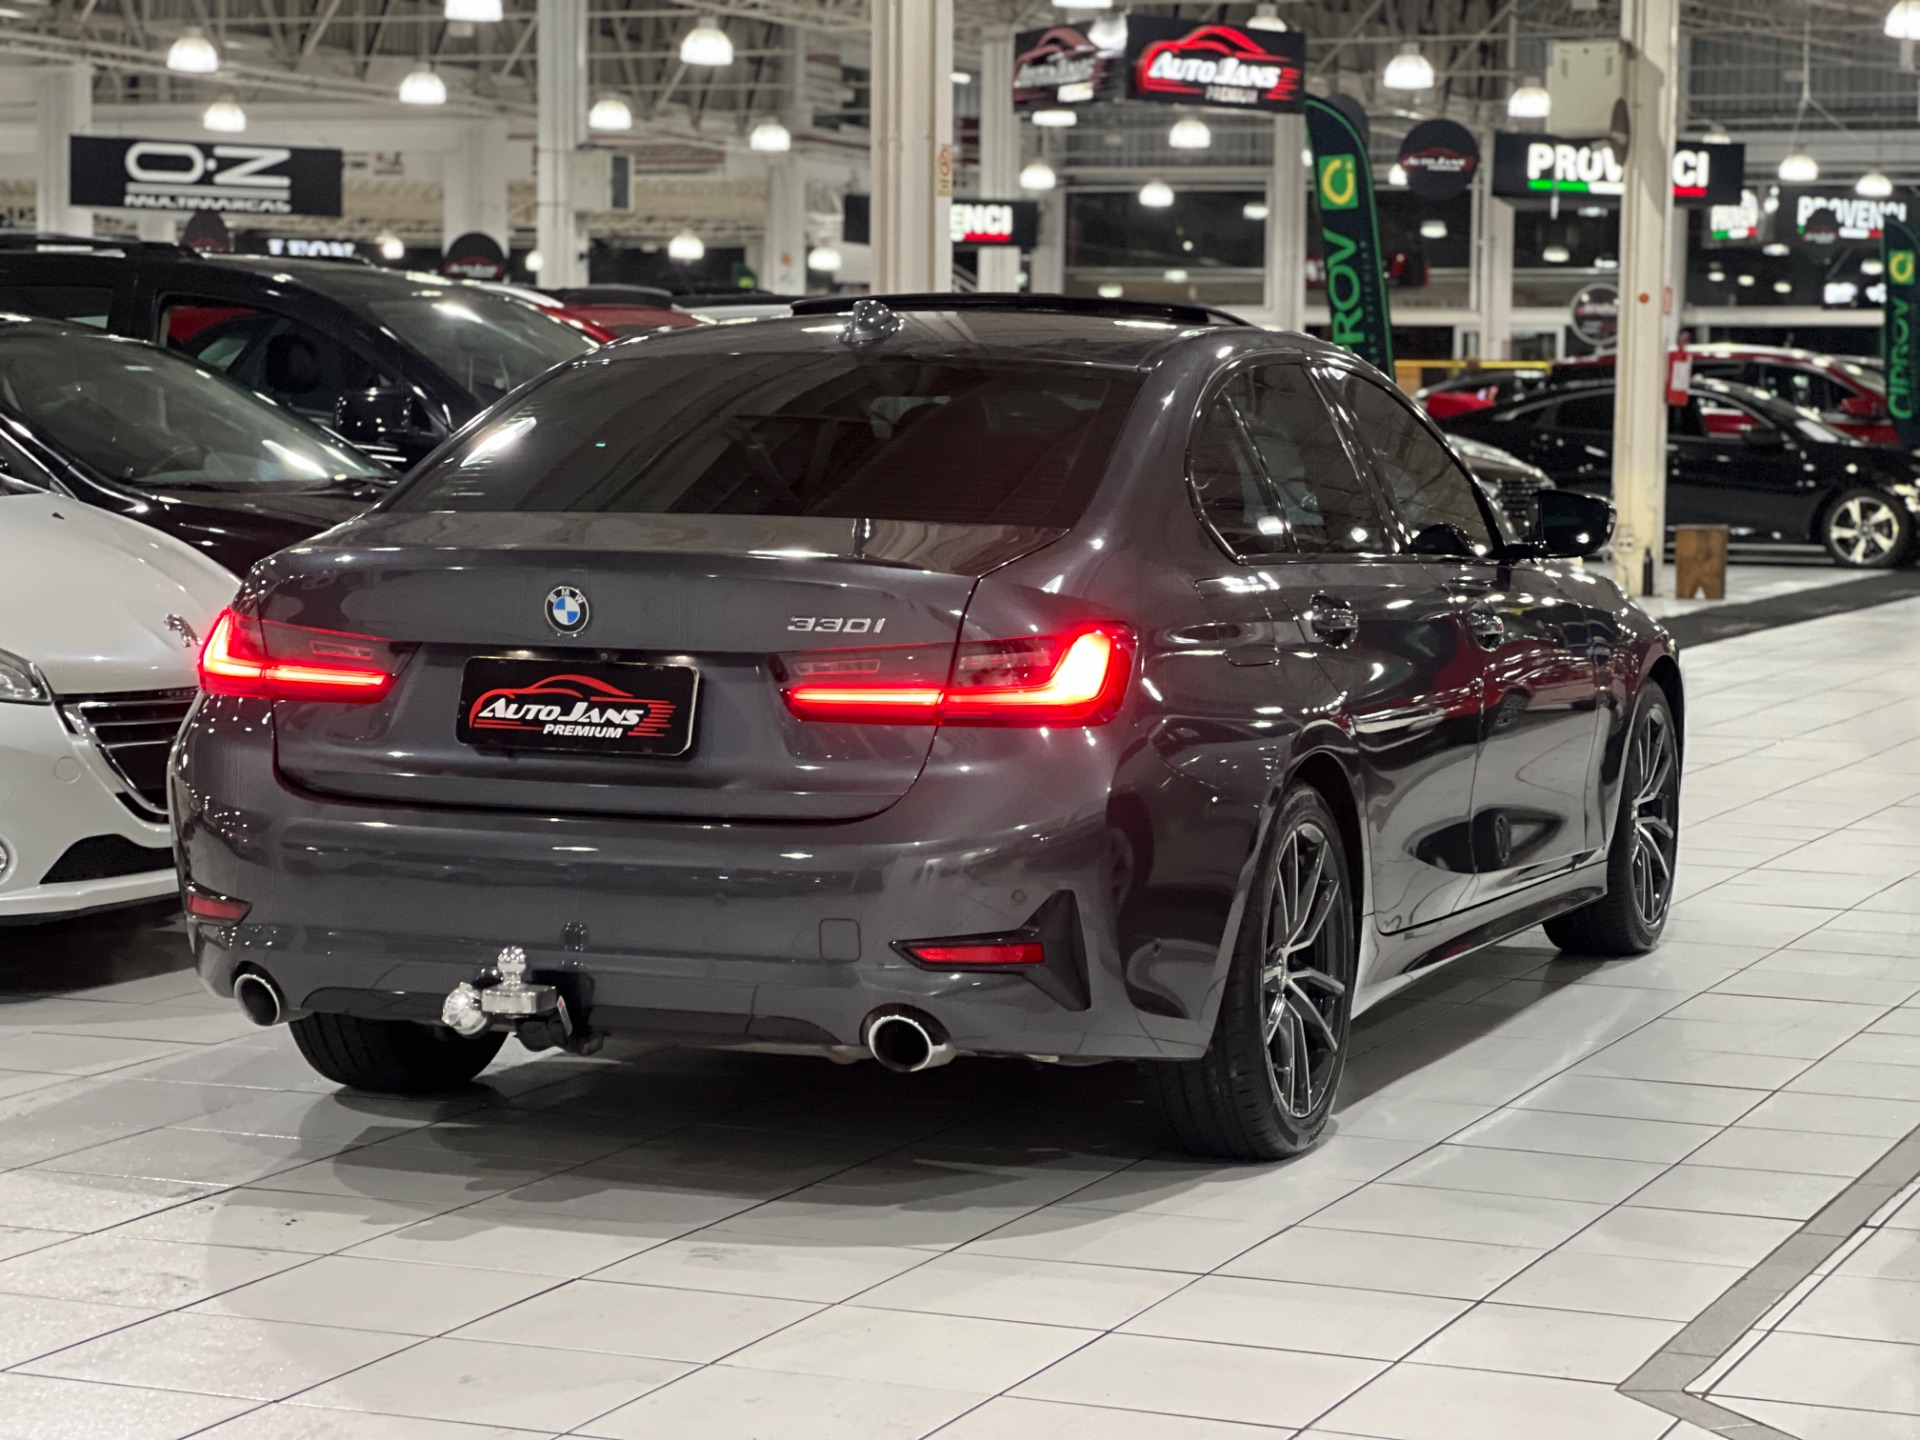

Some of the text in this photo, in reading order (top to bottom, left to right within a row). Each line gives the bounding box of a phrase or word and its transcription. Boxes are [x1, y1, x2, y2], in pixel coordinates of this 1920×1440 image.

[1527, 143, 1710, 187] PROVCI
[950, 204, 1012, 235] ENCI
[1323, 228, 1366, 352] ROV
[548, 588, 585, 604] BMW
[543, 723, 623, 739] PREMIUM
